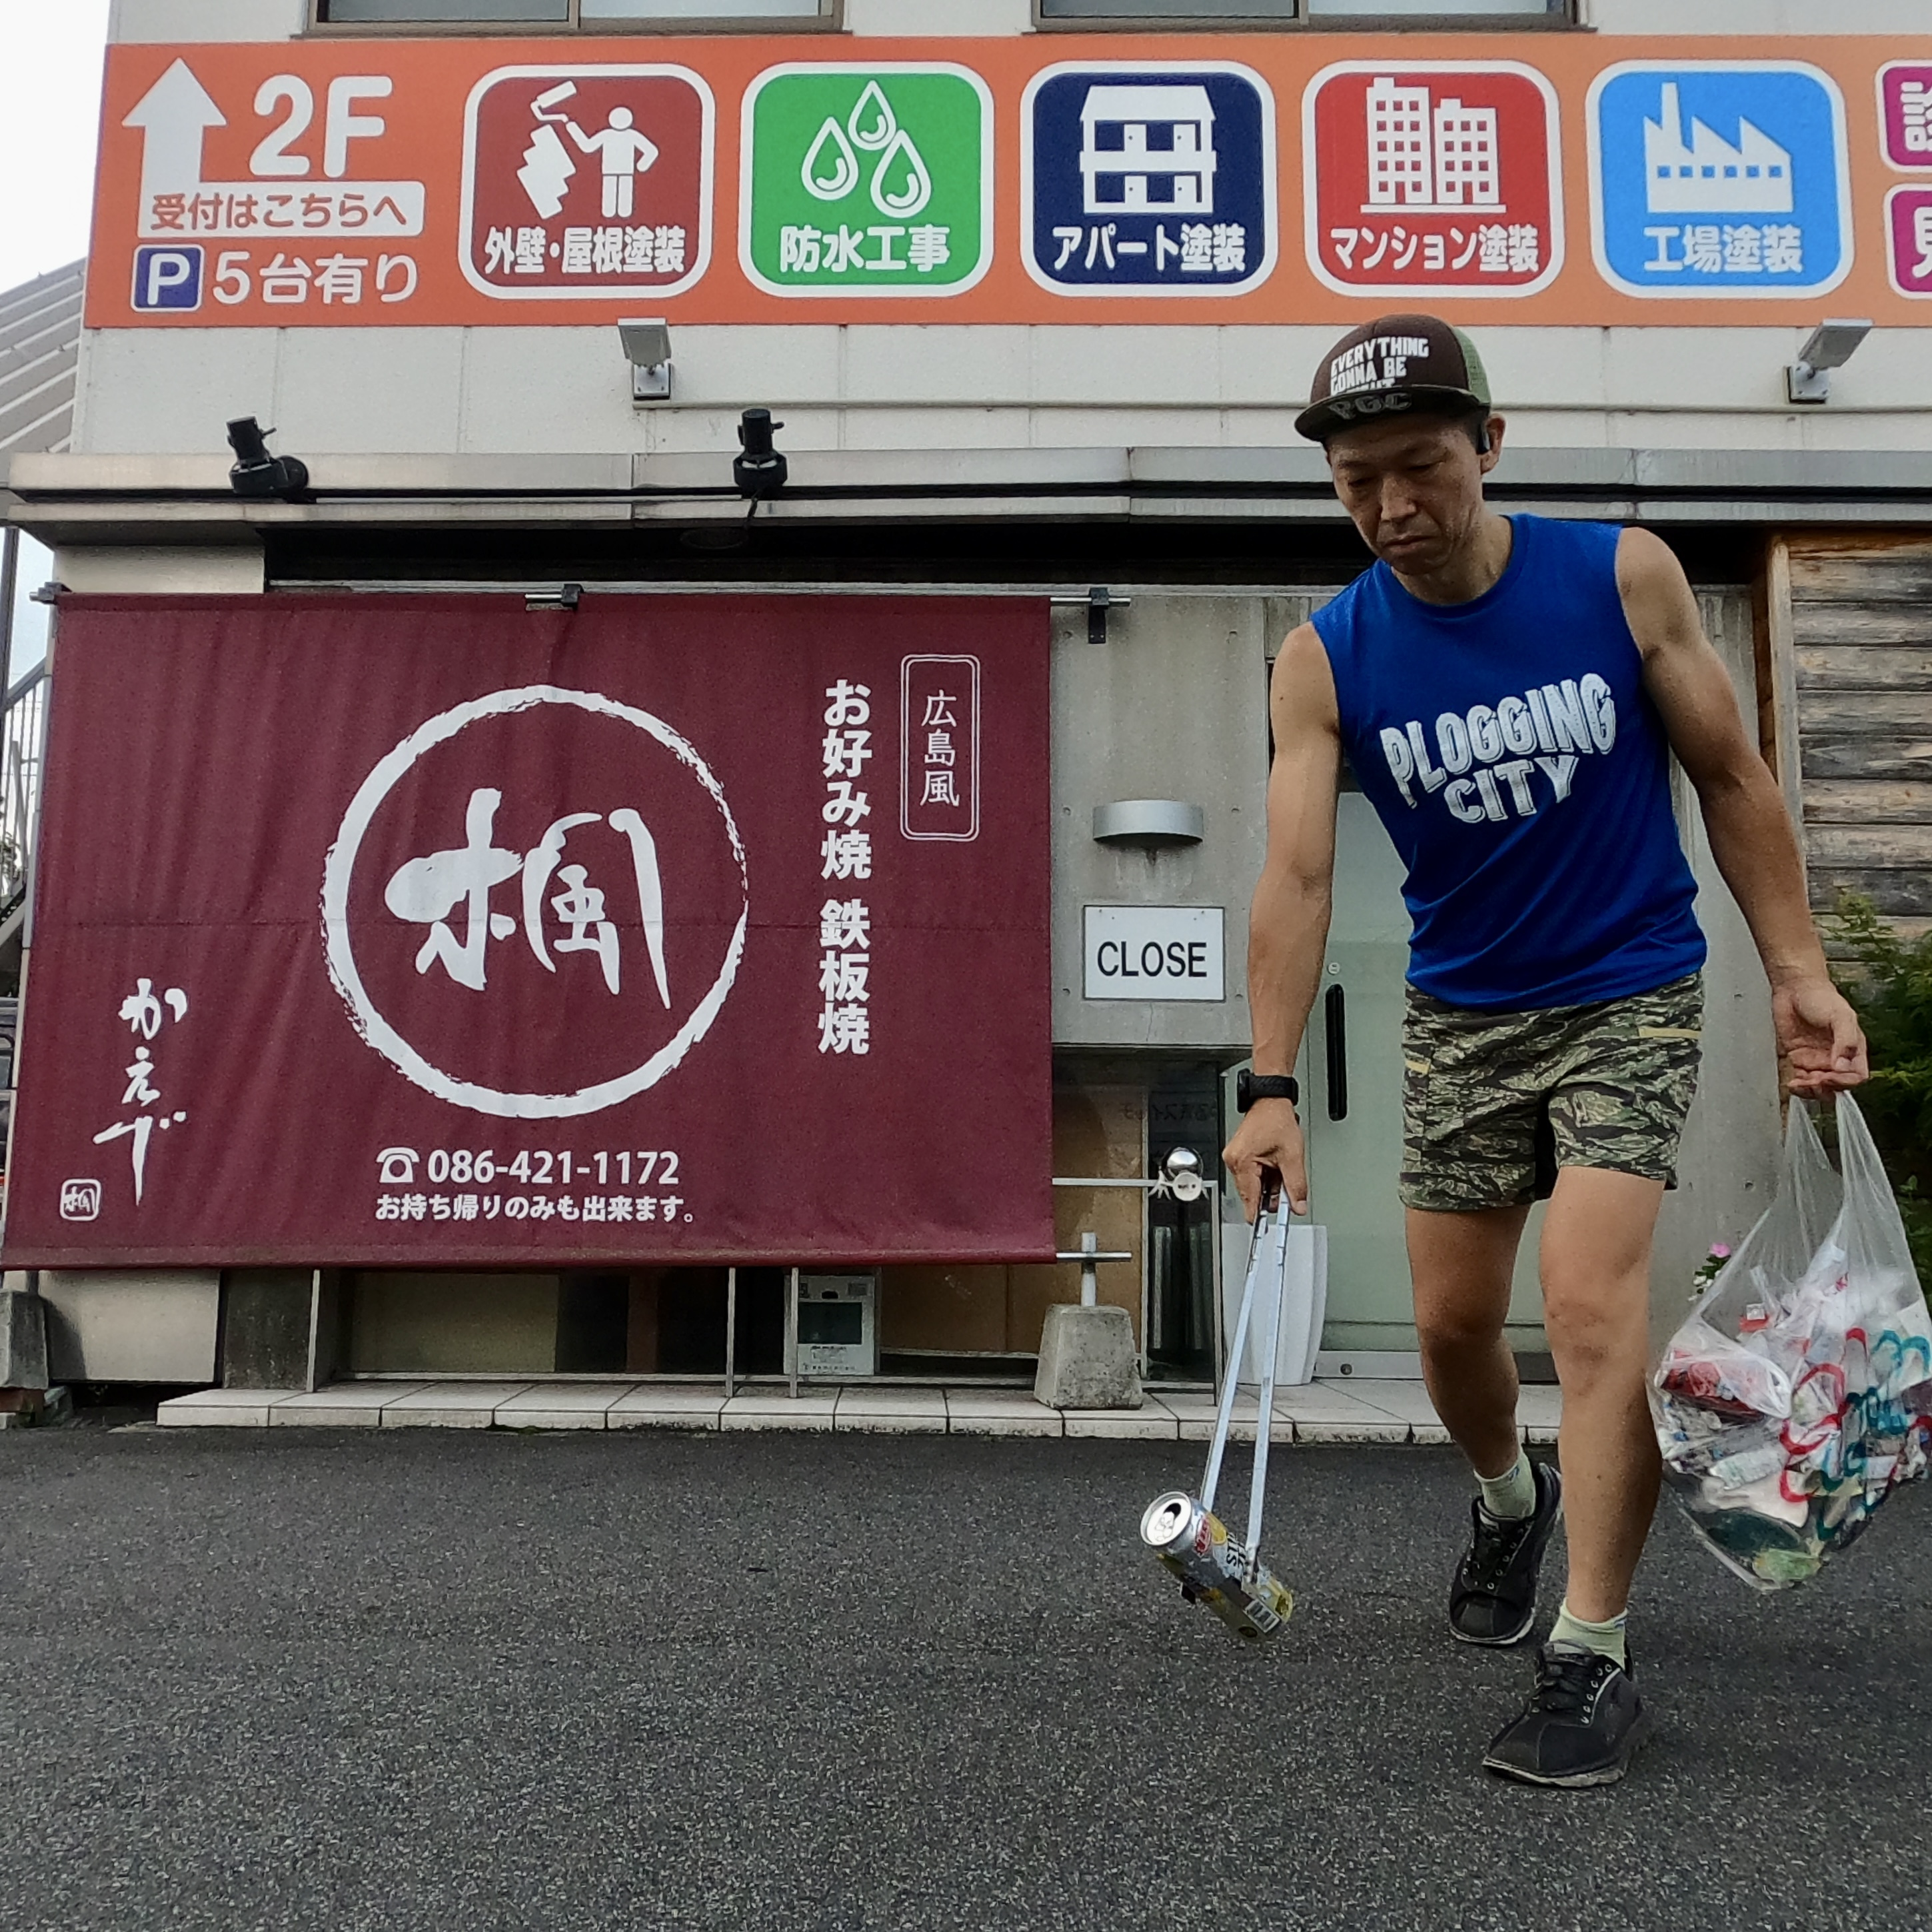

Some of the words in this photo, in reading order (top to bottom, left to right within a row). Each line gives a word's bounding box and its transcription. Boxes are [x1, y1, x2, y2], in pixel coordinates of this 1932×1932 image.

[249, 74, 393, 179] 2F
[151, 193, 407, 230] 受付はこちらへ
[484, 225, 686, 274] 外壁・屋根塗装
[780, 225, 951, 273] 防水工事
[1052, 223, 1246, 273] アパート塗装
[1330, 225, 1539, 273] マンション塗装
[1644, 224, 1803, 273] 工場塗装
[147, 253, 191, 305] P
[213, 251, 419, 305] 5台有り
[1330, 360, 1378, 397] GONNA
[1384, 356, 1408, 379] BE
[1331, 336, 1430, 380] EVERYTHING
[920, 689, 960, 807] 広島風
[1380, 672, 1616, 808] PLOGGING
[820, 679, 872, 880] お好み焼
[1444, 754, 1579, 824] CITY
[817, 898, 871, 1055] 鉄板焼
[1097, 941, 1207, 978] CLOSE
[427, 1149, 680, 1185] 086-421-1172
[375, 1194, 694, 1223] お持ち帰りのみも出来ます。
